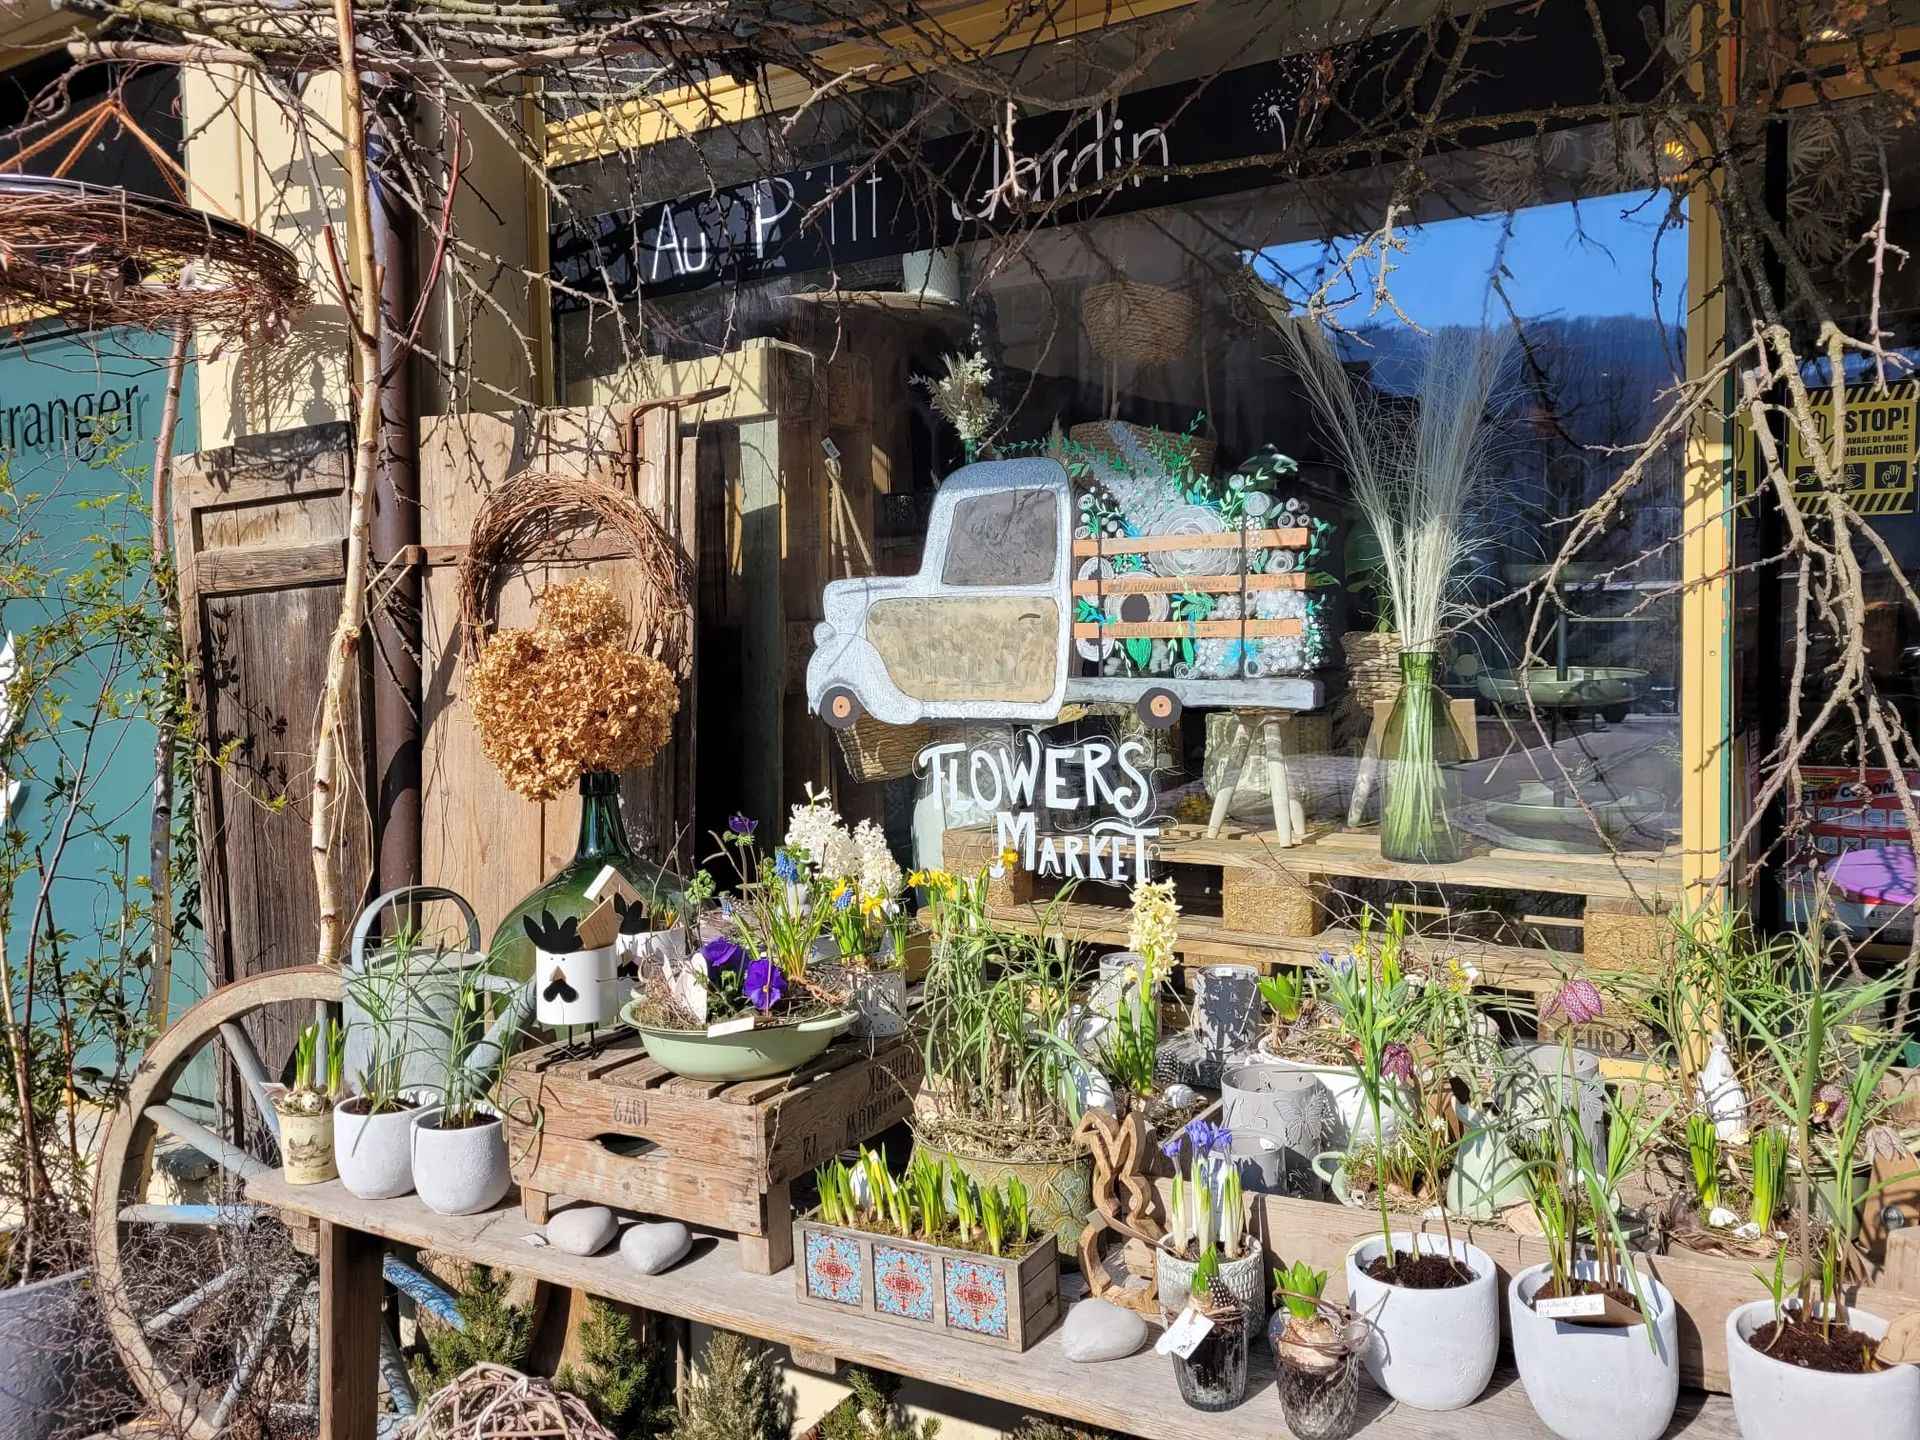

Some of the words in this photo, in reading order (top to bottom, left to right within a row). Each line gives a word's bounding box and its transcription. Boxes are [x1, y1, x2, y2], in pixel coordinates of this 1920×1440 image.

[651, 203, 707, 280] Au
[951, 105, 1170, 221] Jardin
[1845, 406, 1910, 433] STOP!
[1846, 435, 1872, 446] AVAGE
[1872, 434, 1882, 444] DE
[1883, 433, 1909, 443] MAINS
[917, 733, 1150, 819] FLOWERS
[1802, 789, 1837, 802] STOP
[989, 810, 1160, 884] MARKET
